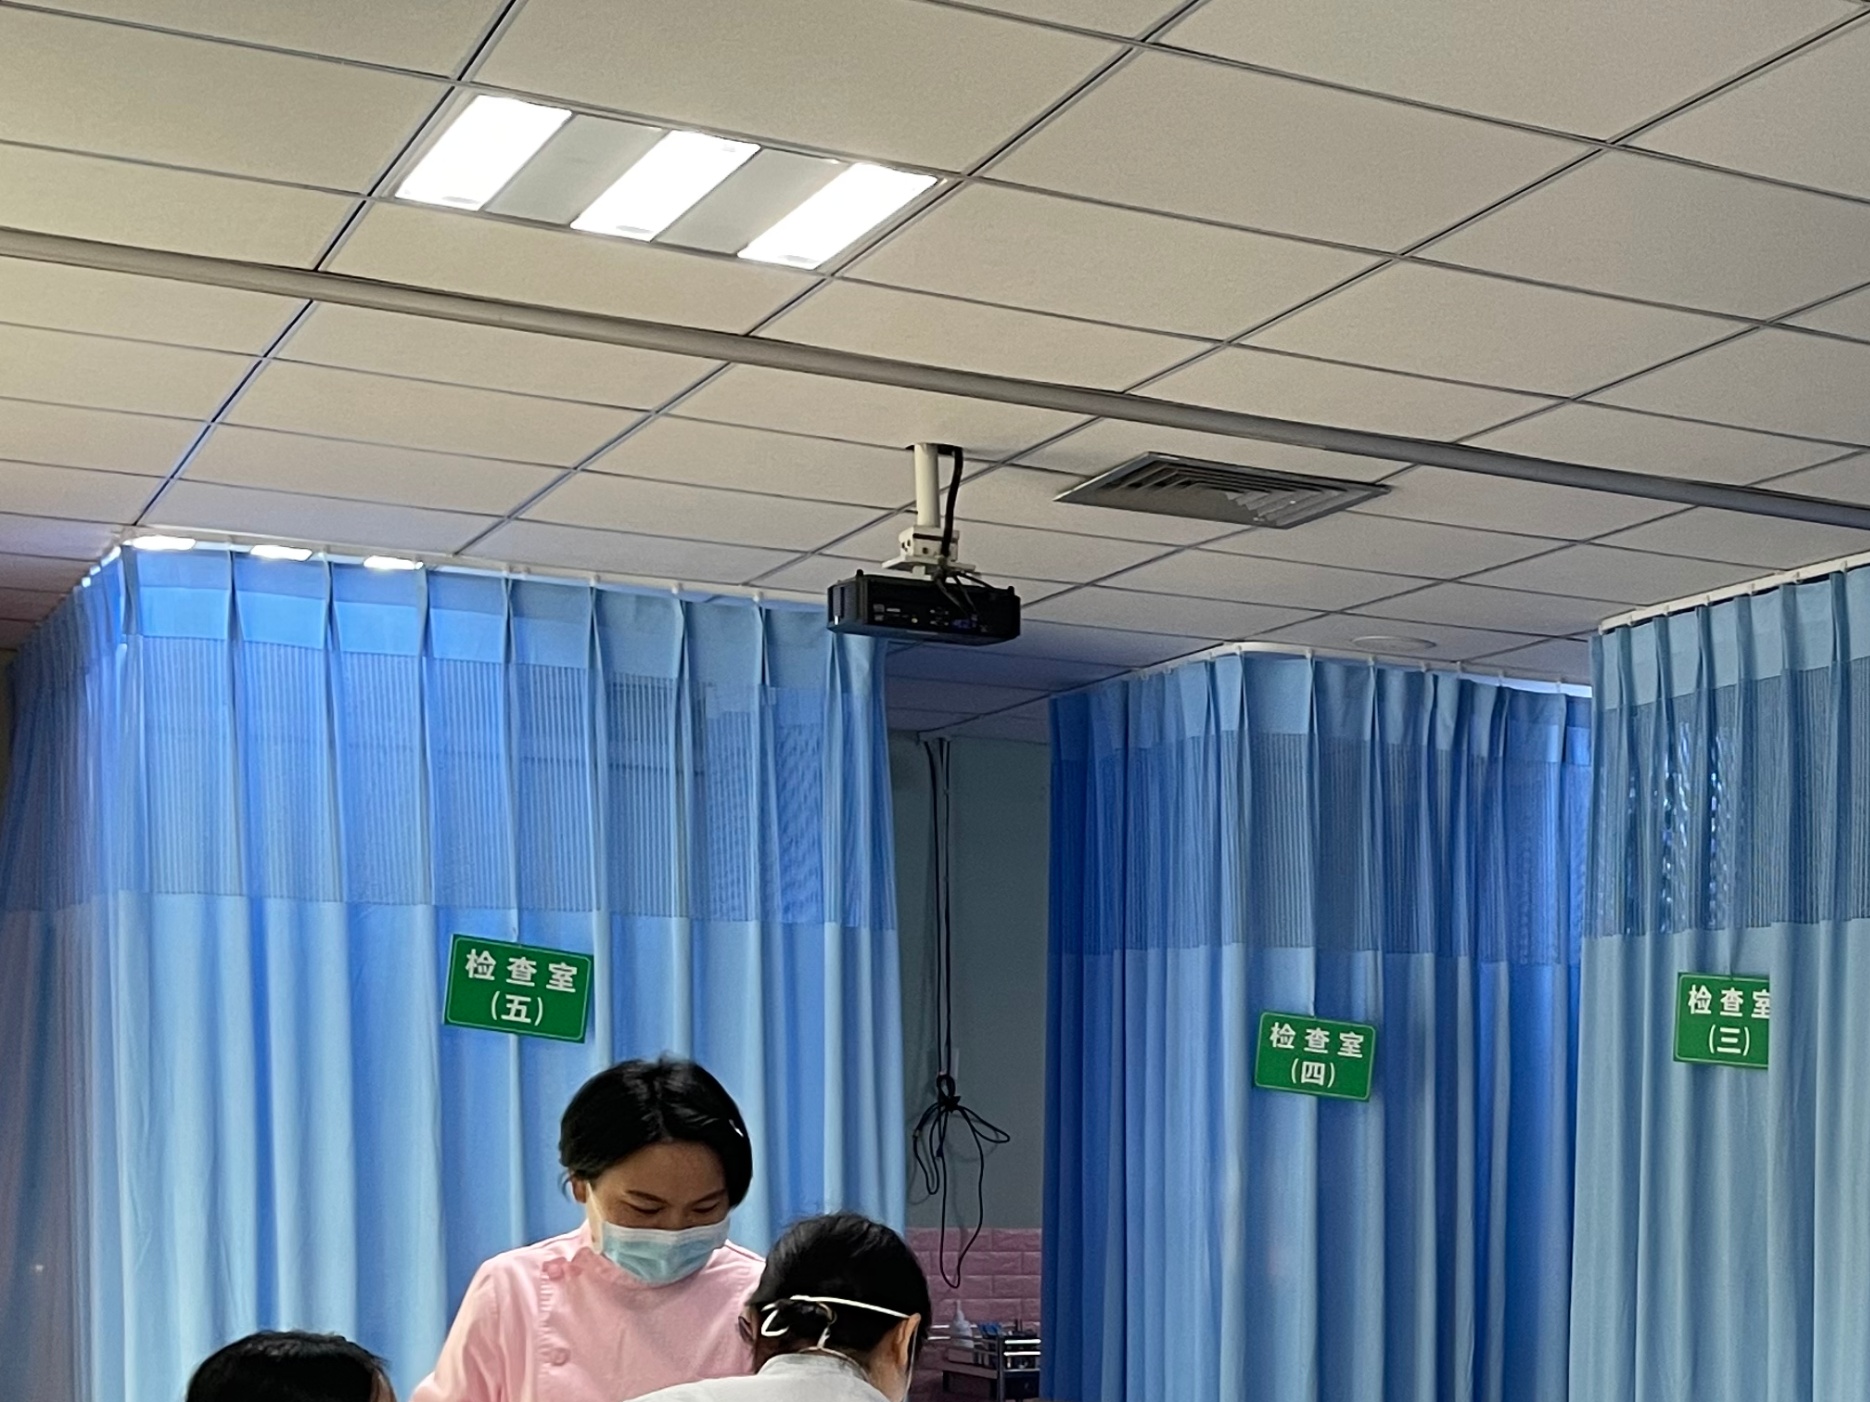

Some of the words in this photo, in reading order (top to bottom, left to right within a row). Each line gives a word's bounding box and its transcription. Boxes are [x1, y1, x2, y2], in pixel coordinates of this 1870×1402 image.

[465, 948, 578, 993] 检查室
[491, 990, 544, 1027] (五)
[1269, 1021, 1364, 1059] 检查室
[1708, 1023, 1750, 1057] (三)
[1291, 1057, 1336, 1089] (四)
